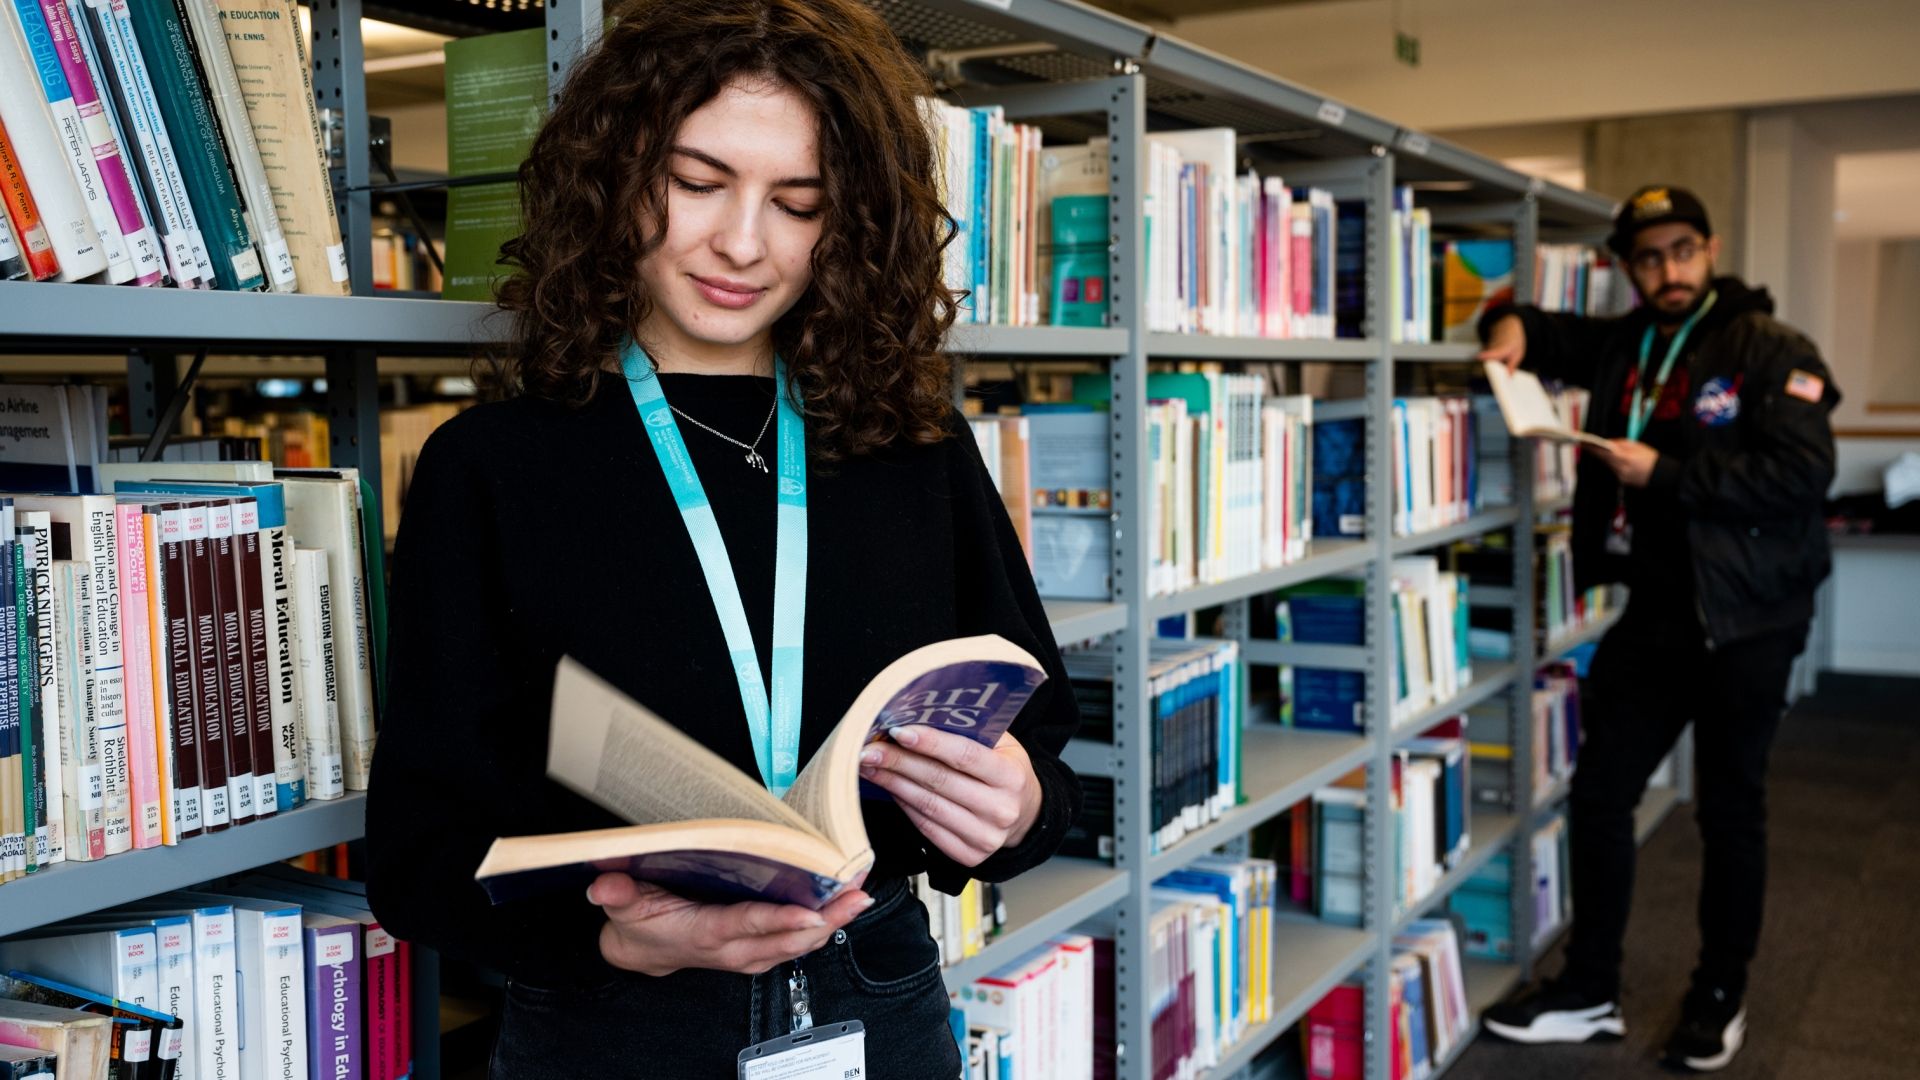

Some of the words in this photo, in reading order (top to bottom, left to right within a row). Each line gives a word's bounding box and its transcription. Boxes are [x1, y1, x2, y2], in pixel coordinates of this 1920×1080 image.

[45, 5, 56, 20] John
[56, 2, 76, 40] Educational
[69, 41, 81, 64] Essays
[166, 19, 174, 32] OF
[231, 11, 280, 19] EDUCATION
[21, 2, 61, 86] TEACHING
[103, 12, 112, 32] Who
[110, 33, 120, 58] Cares
[119, 60, 130, 85] About
[126, 86, 146, 132] Education?
[121, 18, 130, 38] Who
[127, 39, 137, 62] Cares
[135, 64, 146, 89] About
[143, 89, 163, 136] Education?
[191, 99, 204, 126] STUDY
[200, 127, 208, 140] OF
[291, 9, 304, 62] LANGUAGE
[302, 67, 310, 88] AND
[307, 92, 322, 144] CONCEPTS
[320, 162, 335, 217] EDUCATION
[62, 117, 82, 157] PETER
[76, 158, 97, 201] JARVIS
[203, 141, 225, 196] CURRICULUM
[18, 192, 31, 219] Peters
[145, 144, 156, 166] ERIC
[154, 168, 179, 230] MACFARLANE
[162, 147, 173, 169] ERIC
[170, 171, 194, 232] MACFARLANE
[230, 208, 240, 227] Allyn
[7, 397, 39, 414] Airline
[91, 511, 104, 552] English
[105, 510, 116, 565] Tradition
[136, 516, 147, 590] SCHOOLING
[35, 527, 50, 593] PATRICK
[95, 556, 107, 595] Liberal
[108, 569, 117, 590] and
[130, 549, 139, 592] DOLE?
[271, 530, 288, 591] Moral
[80, 574, 90, 598] Moral
[353, 576, 363, 621] Susan
[6, 605, 17, 655] EDUCATION
[18, 593, 28, 655] DESCHOOLING
[82, 605, 91, 652] Education
[97, 600, 108, 656] Education
[110, 594, 119, 638] Change
[224, 611, 240, 660] MORAL
[250, 608, 266, 657] MORAL
[320, 585, 332, 639] EDUCATION
[38, 599, 53, 687] NUTTGENS
[85, 655, 93, 665] in
[113, 642, 120, 652] in
[172, 618, 187, 667] MORAL
[199, 614, 215, 664] MORAL
[275, 597, 293, 704] Education
[356, 625, 367, 670] Isaacs
[8, 656, 17, 676] AND
[21, 658, 29, 696] SOCIETY
[99, 678, 108, 686] an
[323, 642, 336, 702] DEMOCRACY
[9, 678, 20, 727] EXPERTISE
[86, 679, 95, 722] Changing
[101, 693, 123, 703] history
[175, 672, 194, 747] EDUCATION
[202, 666, 221, 742] EDUCATION
[228, 662, 246, 737] EDUCATION
[253, 659, 271, 732] EDUCATION
[88, 727, 97, 760] Society
[116, 736, 126, 783] Sheldon
[282, 725, 290, 749] KAY
[105, 739, 117, 793] Rothblatt
[107, 817, 125, 826] Faber
[186, 813, 199, 821] DUR
[213, 808, 226, 816] DUR
[240, 800, 251, 808] DUR
[263, 797, 275, 805] DUR
[213, 974, 225, 1036] Educational
[280, 975, 292, 1037] Educational
[335, 1035, 349, 1051] in
[845, 1067, 860, 1078] BEN
